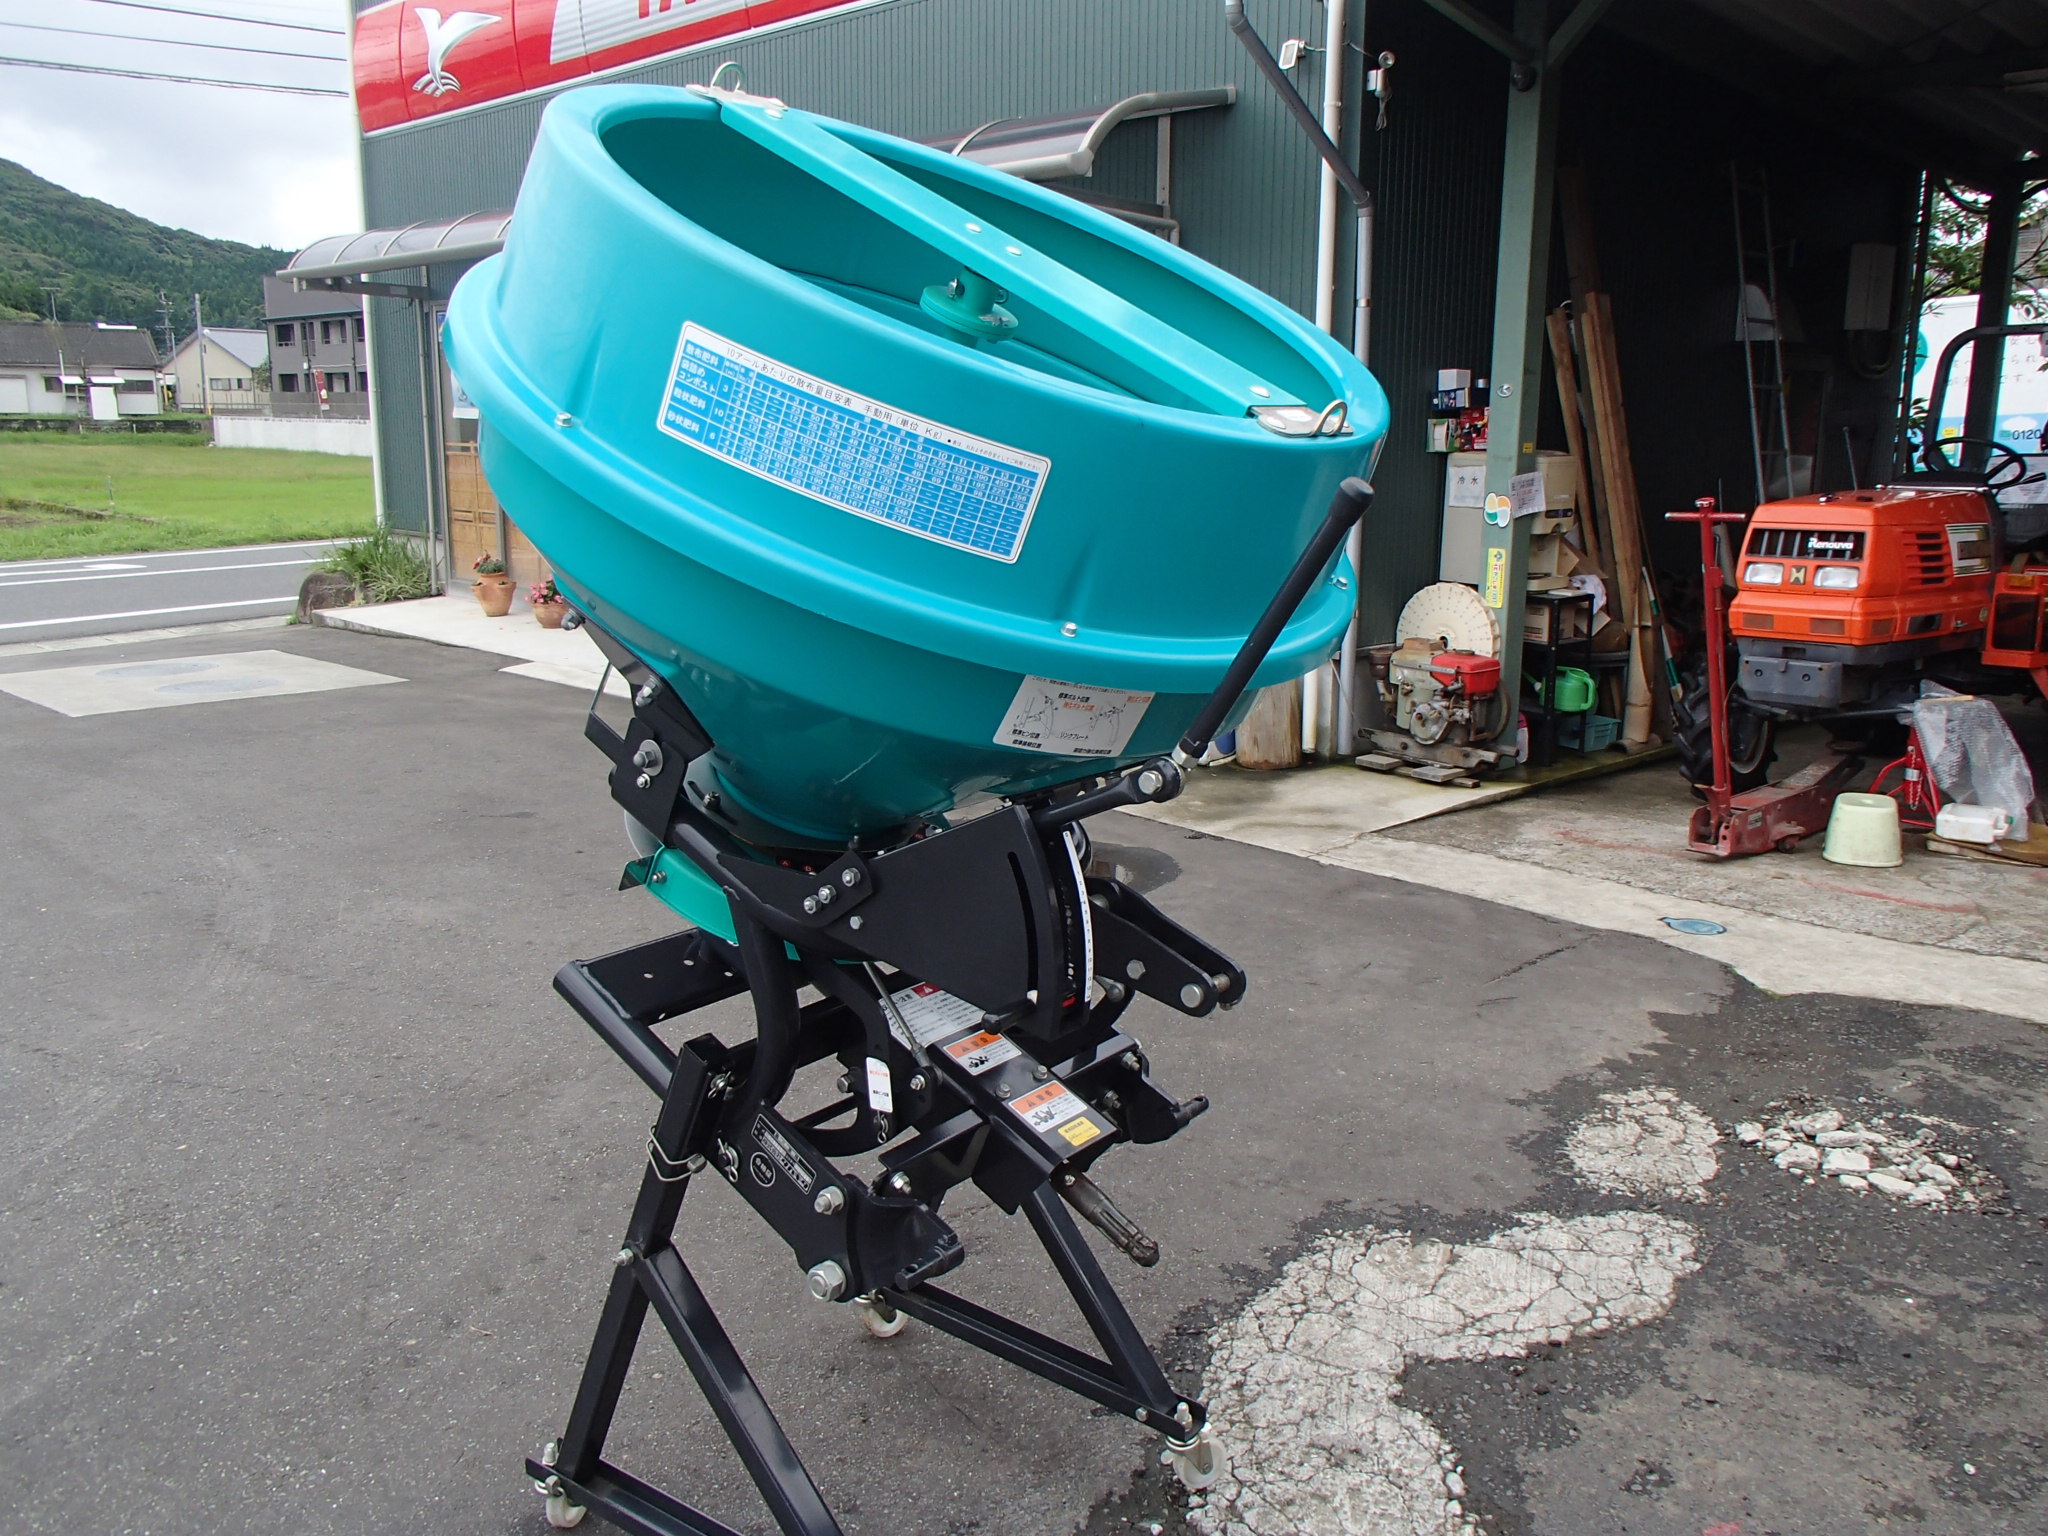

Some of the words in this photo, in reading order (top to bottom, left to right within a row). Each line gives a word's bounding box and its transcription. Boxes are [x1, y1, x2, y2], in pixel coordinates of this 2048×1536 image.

[679, 370, 716, 393] コンポスト
[722, 384, 729, 392] 3
[714, 407, 724, 417] 10
[733, 406, 739, 414] 2
[730, 415, 737, 423] 4
[793, 397, 799, 405] 3
[811, 404, 818, 412] 4
[832, 412, 839, 420] 5
[874, 429, 881, 437] 7
[894, 436, 901, 444] 8
[915, 444, 923, 452] 9
[710, 432, 716, 440] 6
[726, 431, 732, 439] 2
[2012, 429, 2042, 440] 0120
